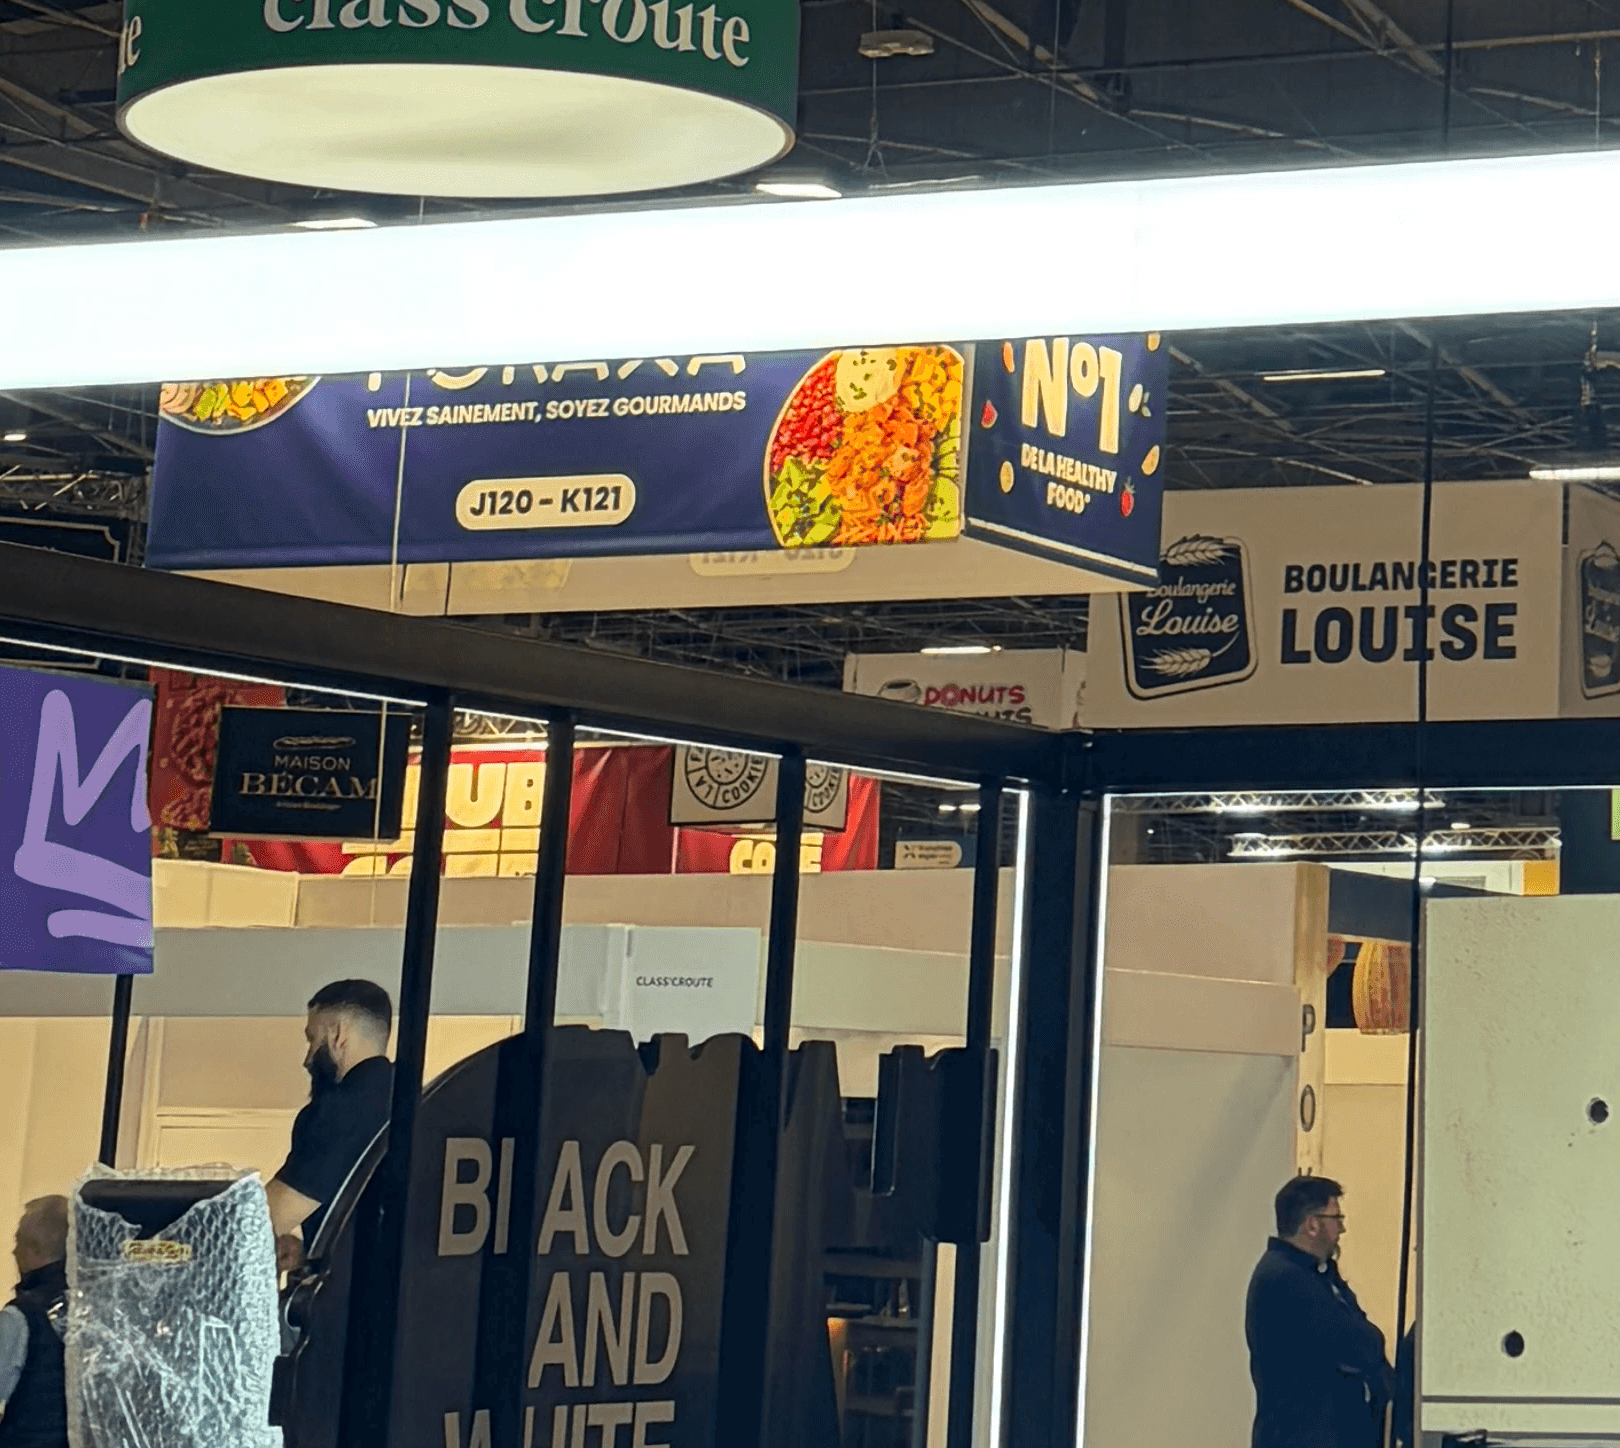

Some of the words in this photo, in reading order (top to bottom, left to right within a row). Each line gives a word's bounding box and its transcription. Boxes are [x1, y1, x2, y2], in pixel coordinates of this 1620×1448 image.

[367, 406, 423, 429] VIVEZ
[425, 401, 542, 425] SAINEMENT,
[546, 398, 610, 421] SOYEZ
[613, 391, 747, 417] GOURMANDS
[1021, 443, 1038, 471] DE
[1038, 449, 1056, 477] LA
[1056, 455, 1118, 494] HEALTHY
[469, 489, 534, 516] J120
[560, 485, 623, 513] K121
[1284, 558, 1518, 594] BOULANGERIE
[1136, 599, 1241, 636] Louise
[1280, 603, 1518, 664] LOUISE
[924, 683, 1026, 707] DONUTS
[274, 755, 351, 771] MAISON
[527, 1271, 684, 1389] AND
